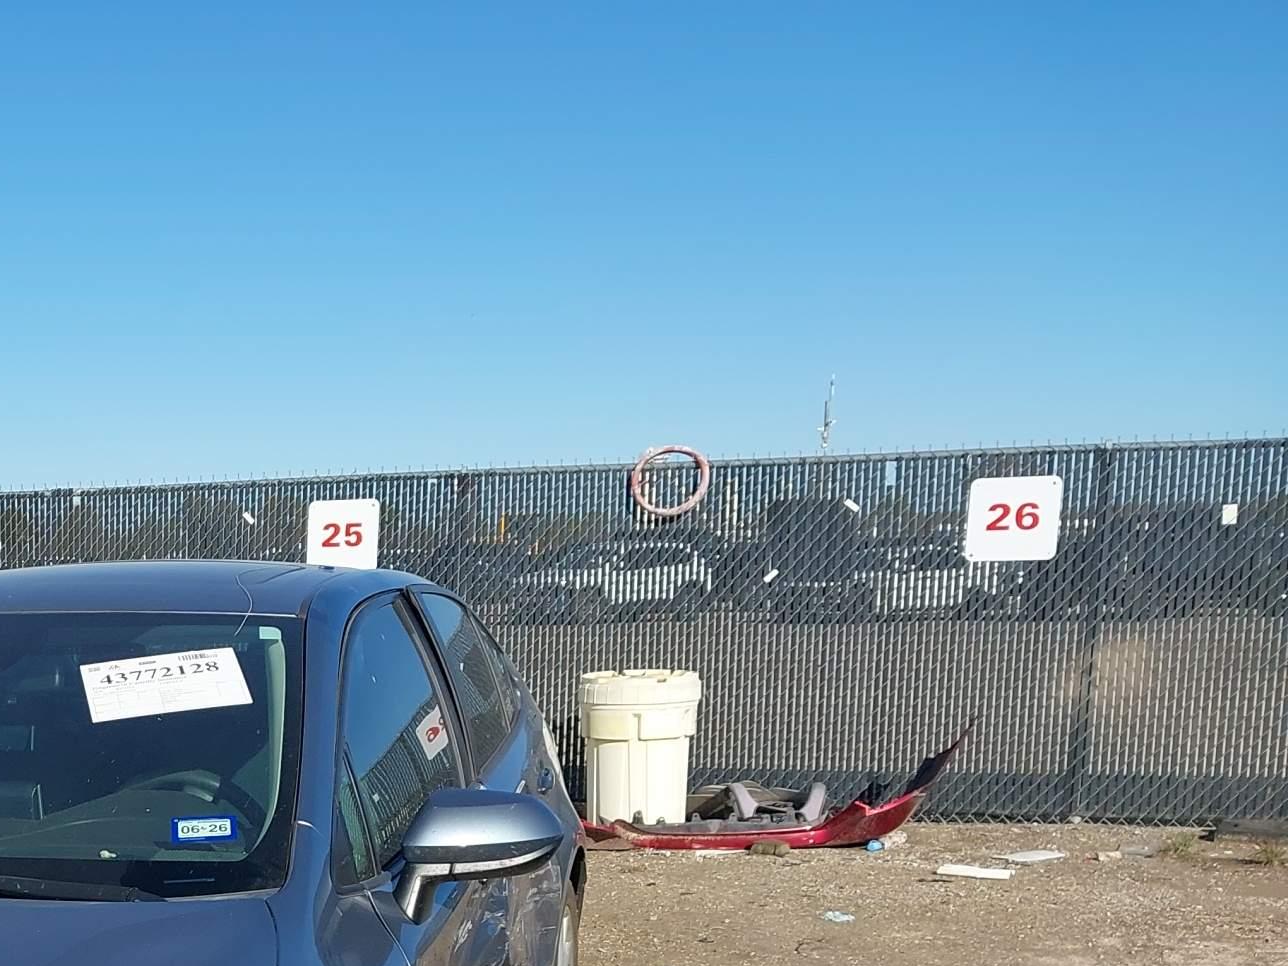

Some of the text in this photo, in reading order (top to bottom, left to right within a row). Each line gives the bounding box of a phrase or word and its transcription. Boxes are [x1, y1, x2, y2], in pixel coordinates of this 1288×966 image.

[985, 502, 1040, 532] 26
[321, 522, 362, 548] 25
[99, 660, 220, 685] 43772128
